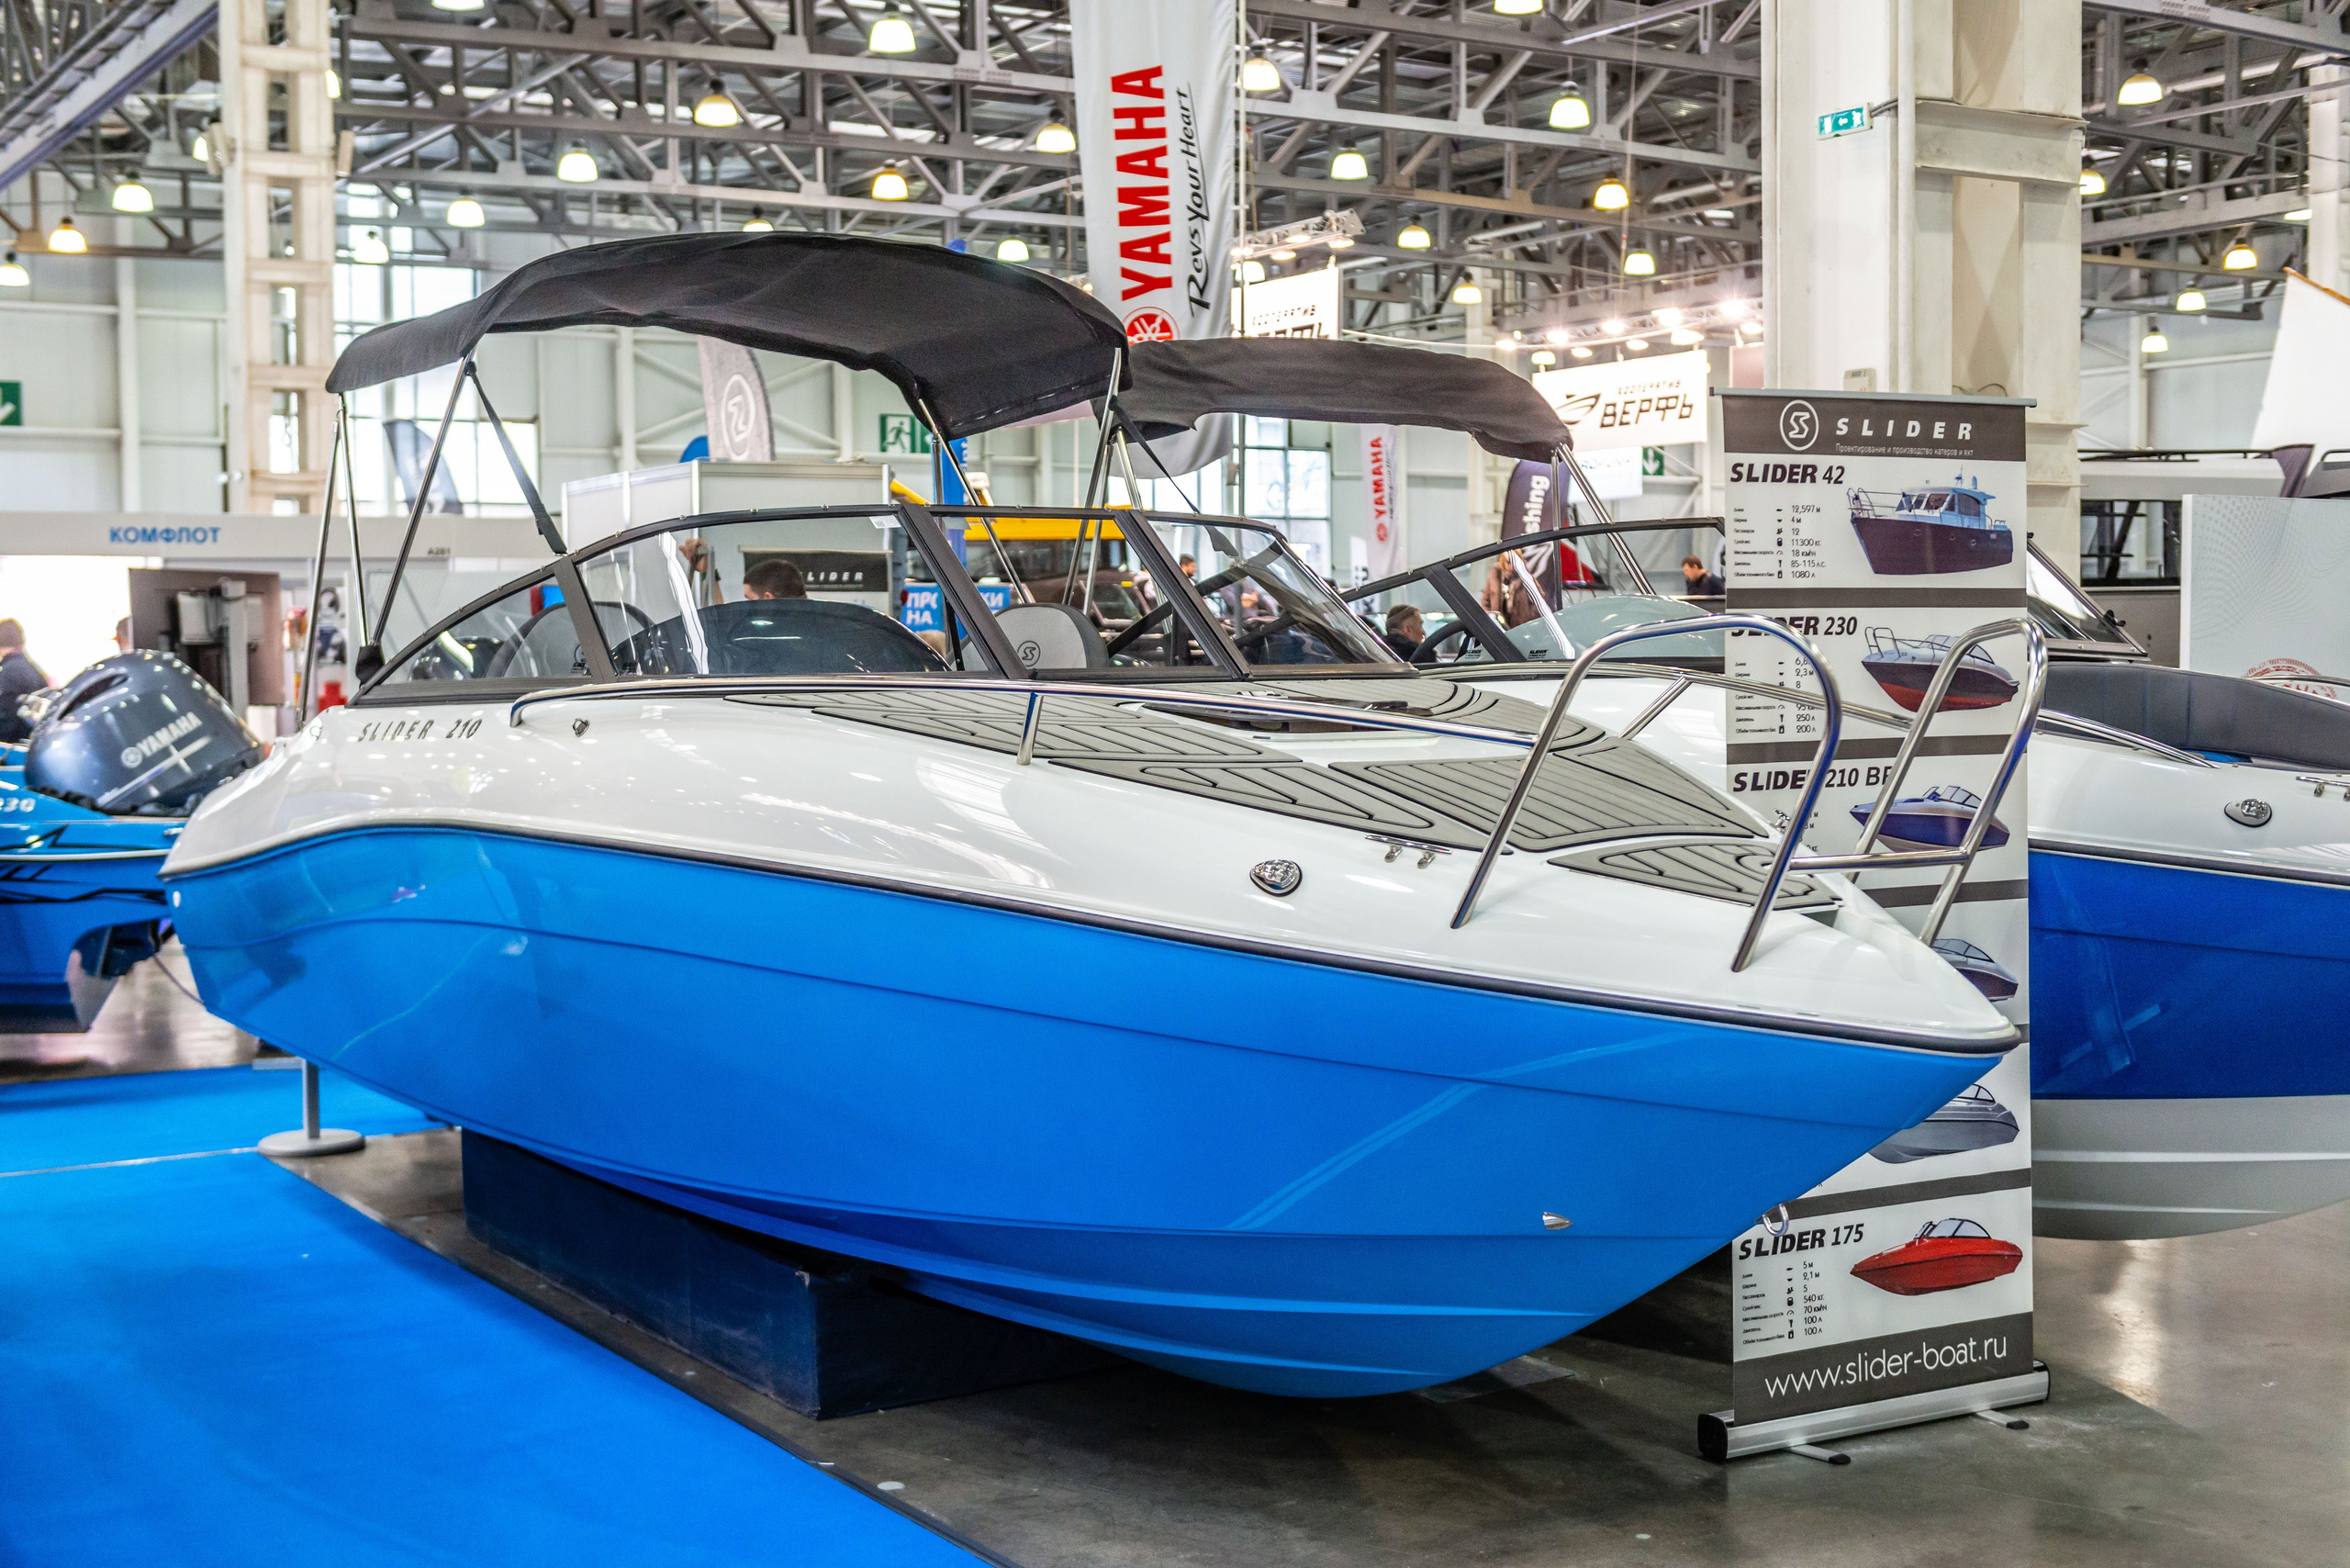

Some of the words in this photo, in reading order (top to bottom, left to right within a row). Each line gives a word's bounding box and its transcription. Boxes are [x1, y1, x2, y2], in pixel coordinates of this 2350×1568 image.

[1177, 86, 1197, 158] Heart
[1111, 65, 1173, 301] YAMAHA
[1186, 159, 1210, 221] Your
[1187, 226, 1210, 318] Revs
[1600, 394, 1694, 428] ВЕРФЬ
[1836, 417, 1973, 441] SLIDER
[1836, 442, 1886, 454] Проектирование
[1893, 446, 1932, 456] производство
[1370, 436, 1387, 520] YAMAHA
[1730, 463, 1818, 483] SLIDER
[1822, 465, 1845, 484] 42
[1521, 475, 1550, 535] shing
[1791, 505, 1815, 514] 12,597
[109, 526, 221, 543] КОМФЛОТ
[803, 571, 864, 582] LIDER
[1791, 570, 1810, 578] 1080
[906, 610, 934, 624] НА
[1824, 616, 1857, 635] 230
[1796, 657, 1810, 666] 6,8
[1796, 668, 1807, 678] 2,3
[1796, 713, 1810, 722] 250
[137, 711, 203, 757] YAMAHA
[358, 720, 435, 742] SLIDER
[445, 718, 483, 739] 210
[1733, 768, 1810, 791] SLIDE
[1825, 767, 1860, 788] 210
[0, 797, 36, 812] 30
[1739, 1228, 1826, 1260] SLIDER
[1831, 1223, 1864, 1246] 175
[1803, 1260, 1807, 1269] 5
[1803, 1271, 1813, 1281] 2,1
[1804, 1294, 1817, 1303] 540
[1804, 1305, 1812, 1314] 70
[1804, 1316, 1817, 1325] 100
[1804, 1327, 1818, 1336] 100
[1765, 1337, 2007, 1398] www.slider-boat.ru
